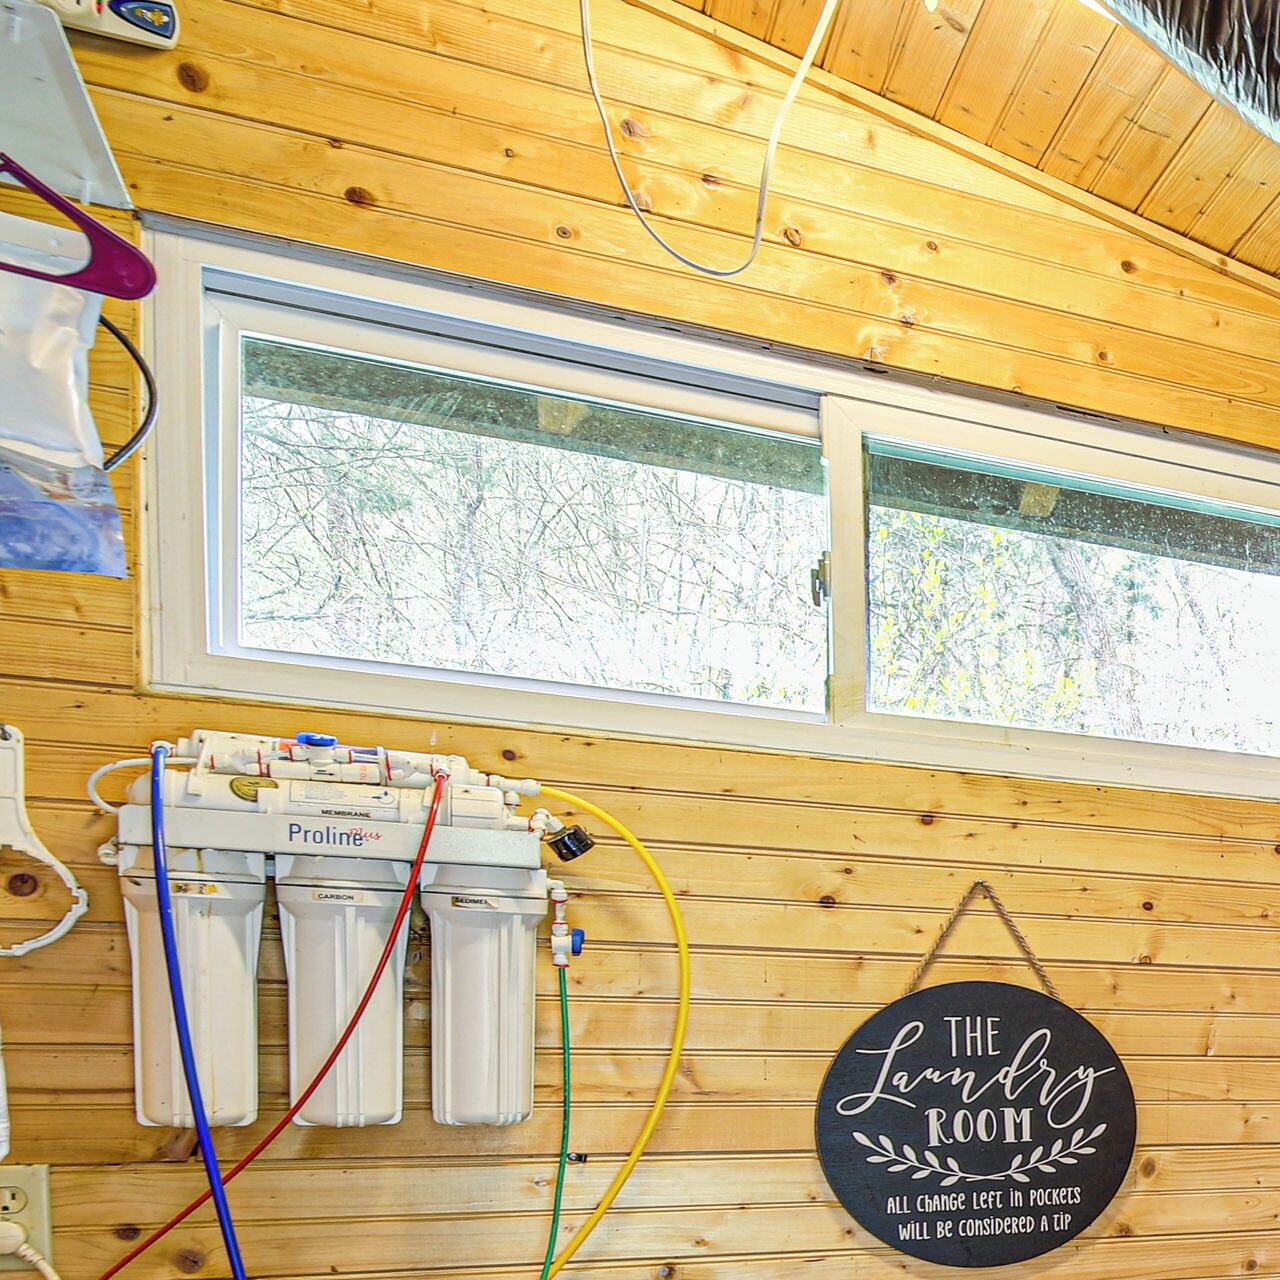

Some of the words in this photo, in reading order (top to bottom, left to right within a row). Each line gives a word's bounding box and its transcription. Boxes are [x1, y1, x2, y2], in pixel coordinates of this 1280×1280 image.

[321, 809, 372, 819] MEMBRANE
[288, 822, 364, 848] Proline
[317, 892, 355, 902] CARBON
[943, 1016, 1001, 1057] THE
[836, 1021, 1116, 1129] Laundry
[924, 1107, 1034, 1147] ROOM
[886, 1196, 911, 1214] ALL
[1040, 1215, 1049, 1232] A
